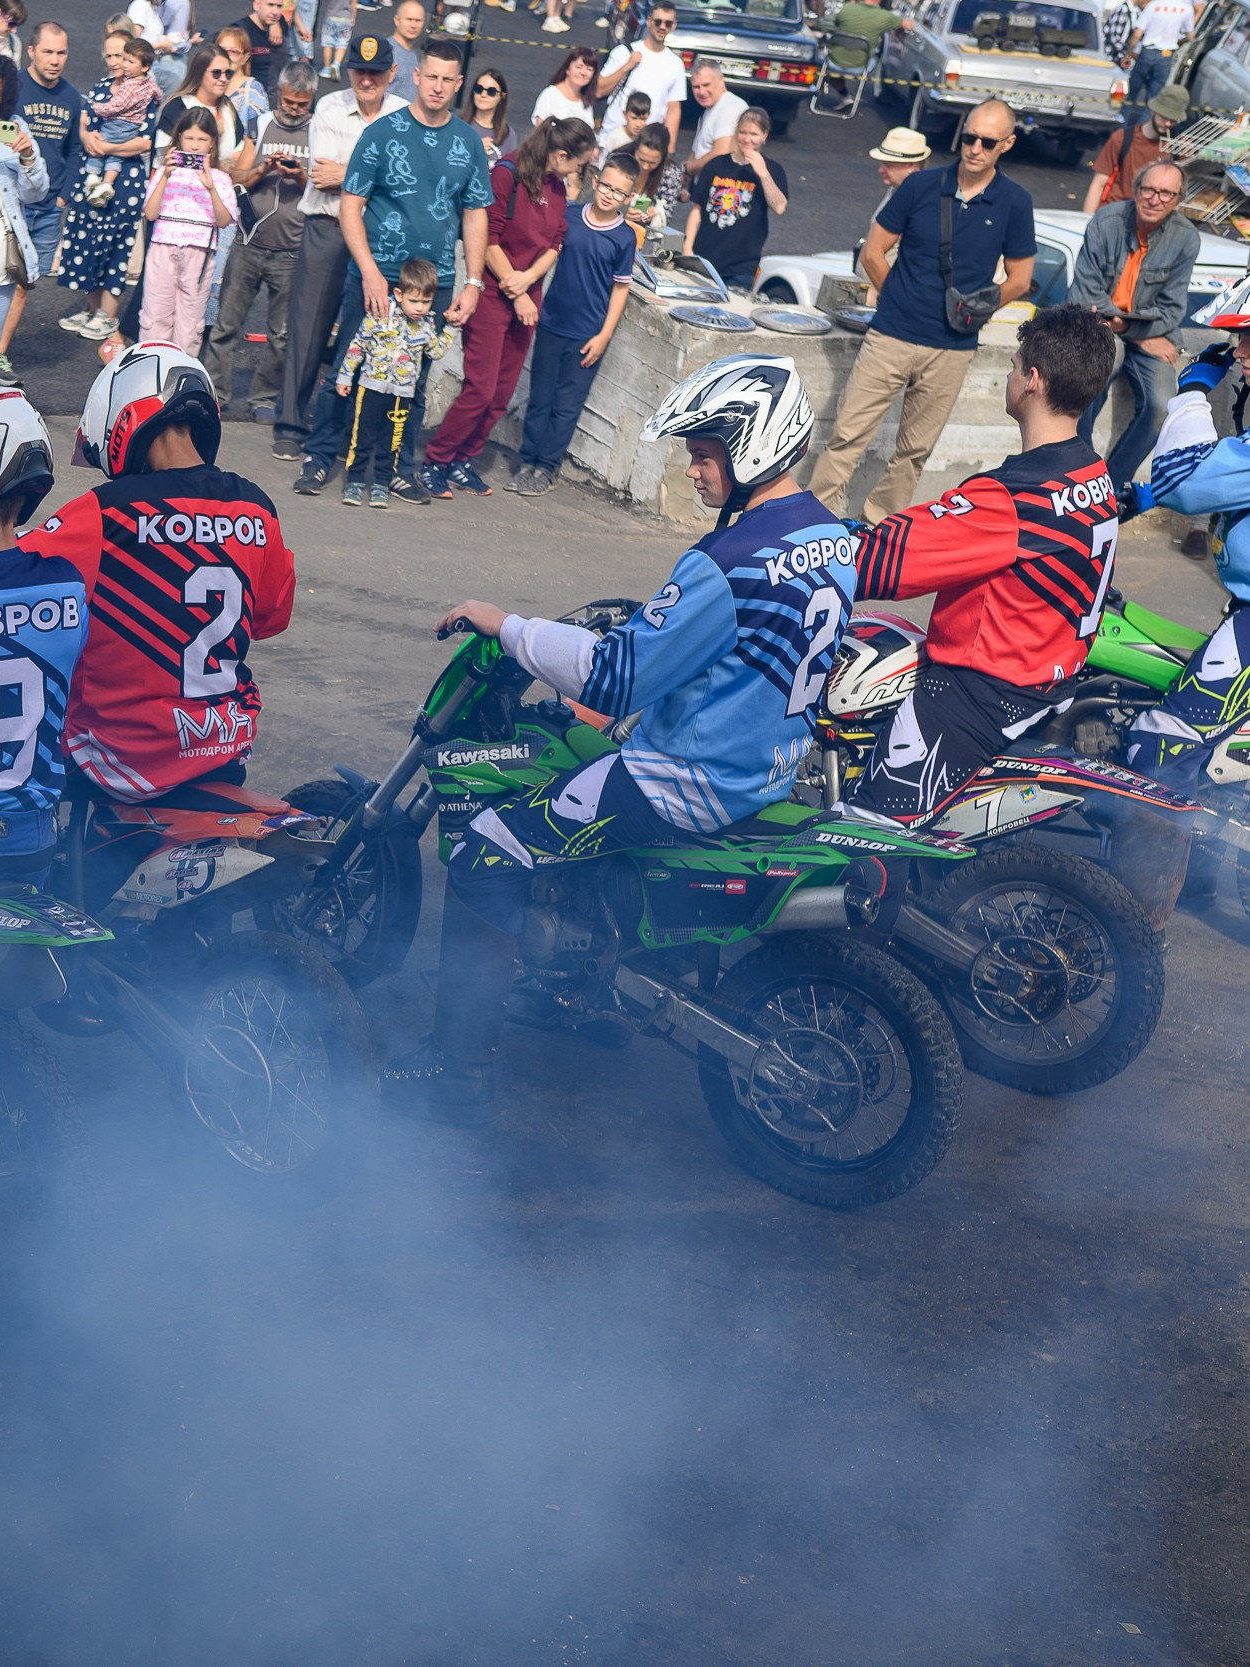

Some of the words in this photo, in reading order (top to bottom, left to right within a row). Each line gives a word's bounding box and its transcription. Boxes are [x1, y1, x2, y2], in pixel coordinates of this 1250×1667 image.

[23, 103, 70, 120] MUSTANG
[110, 410, 131, 465] MOTS
[137, 513, 267, 546] КОВРОВ
[1078, 516, 1119, 638] 7
[642, 582, 680, 629] 2
[183, 566, 243, 699] 2
[786, 586, 843, 717] 2
[178, 744, 235, 759] МОТОДРОМ
[437, 744, 530, 767] Kawasaki
[991, 759, 1068, 776] DUNLOP
[446, 802, 482, 814] ATHENA
[974, 788, 1007, 832] 7
[986, 817, 1031, 837] КОВРОВЕЦ
[815, 832, 898, 853] DUNLOP
